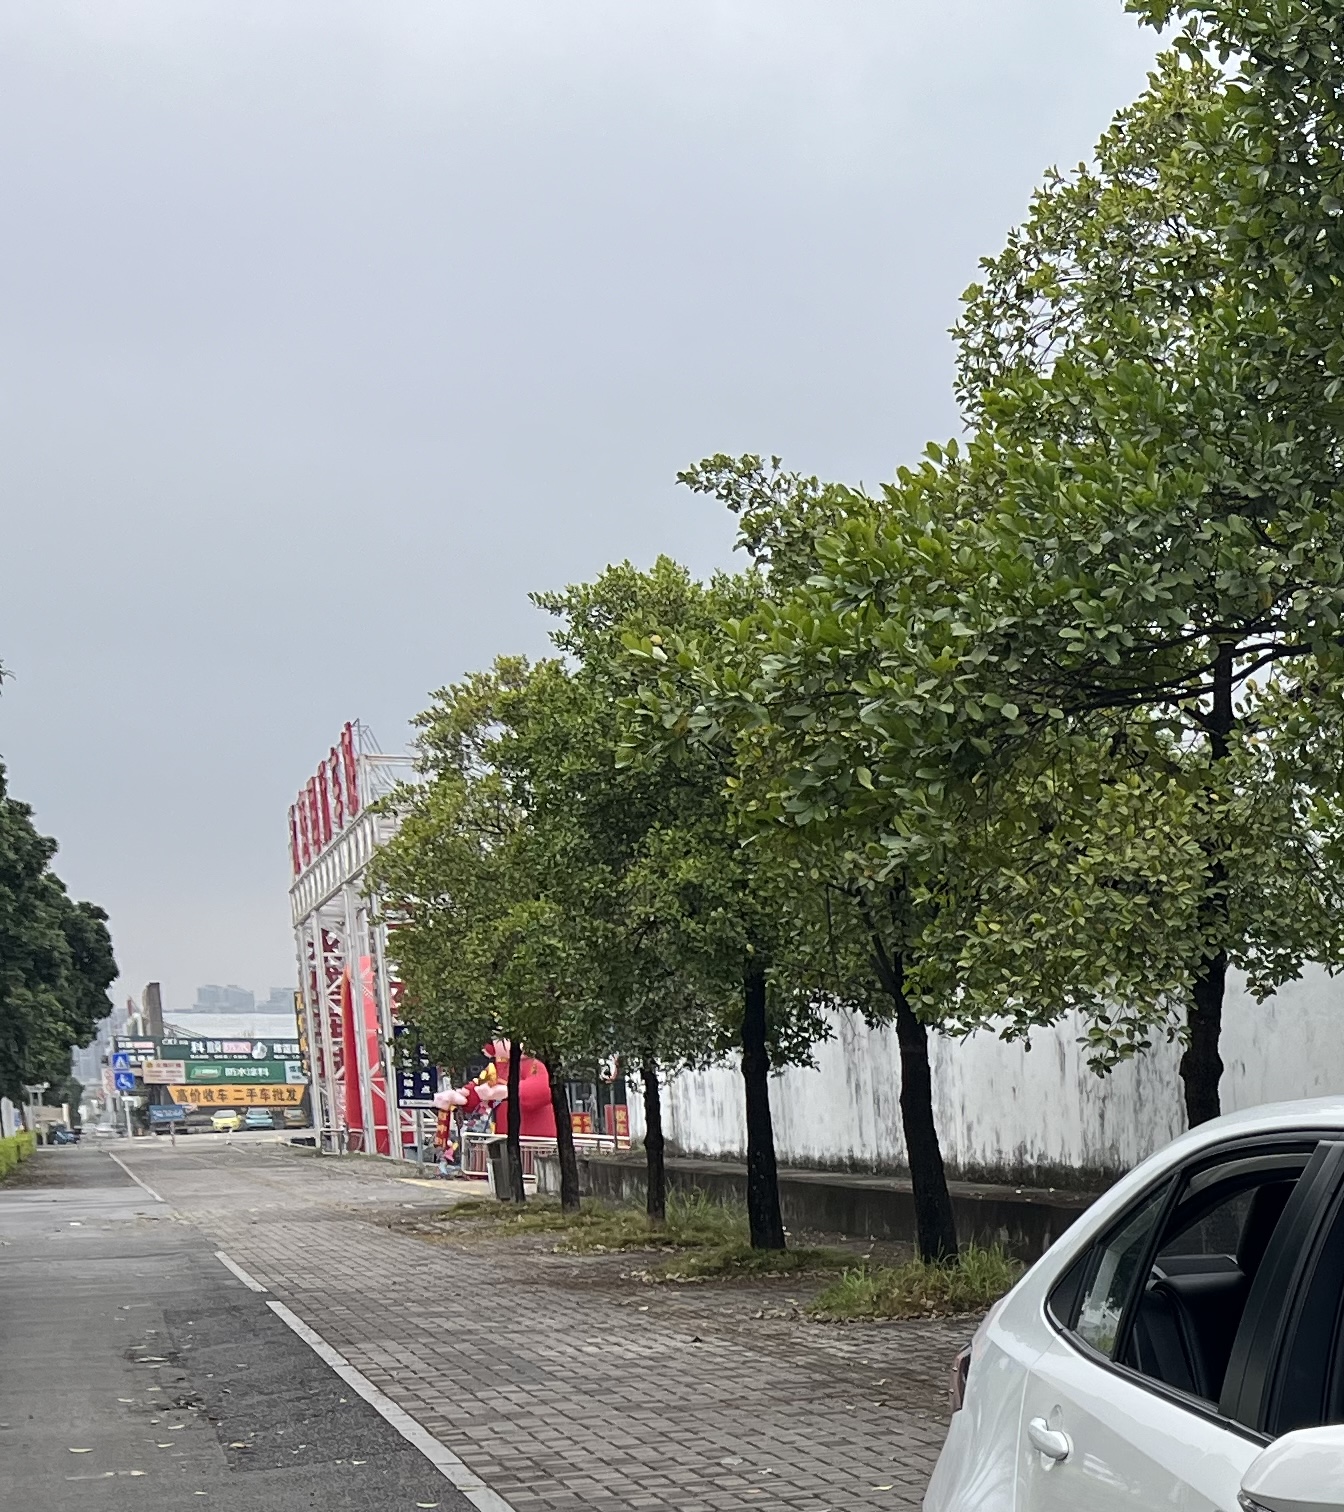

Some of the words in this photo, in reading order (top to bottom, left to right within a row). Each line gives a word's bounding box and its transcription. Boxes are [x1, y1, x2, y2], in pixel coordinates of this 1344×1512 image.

[175, 1088, 229, 1102] 高价收车
[232, 1087, 298, 1102] 二手车批发
